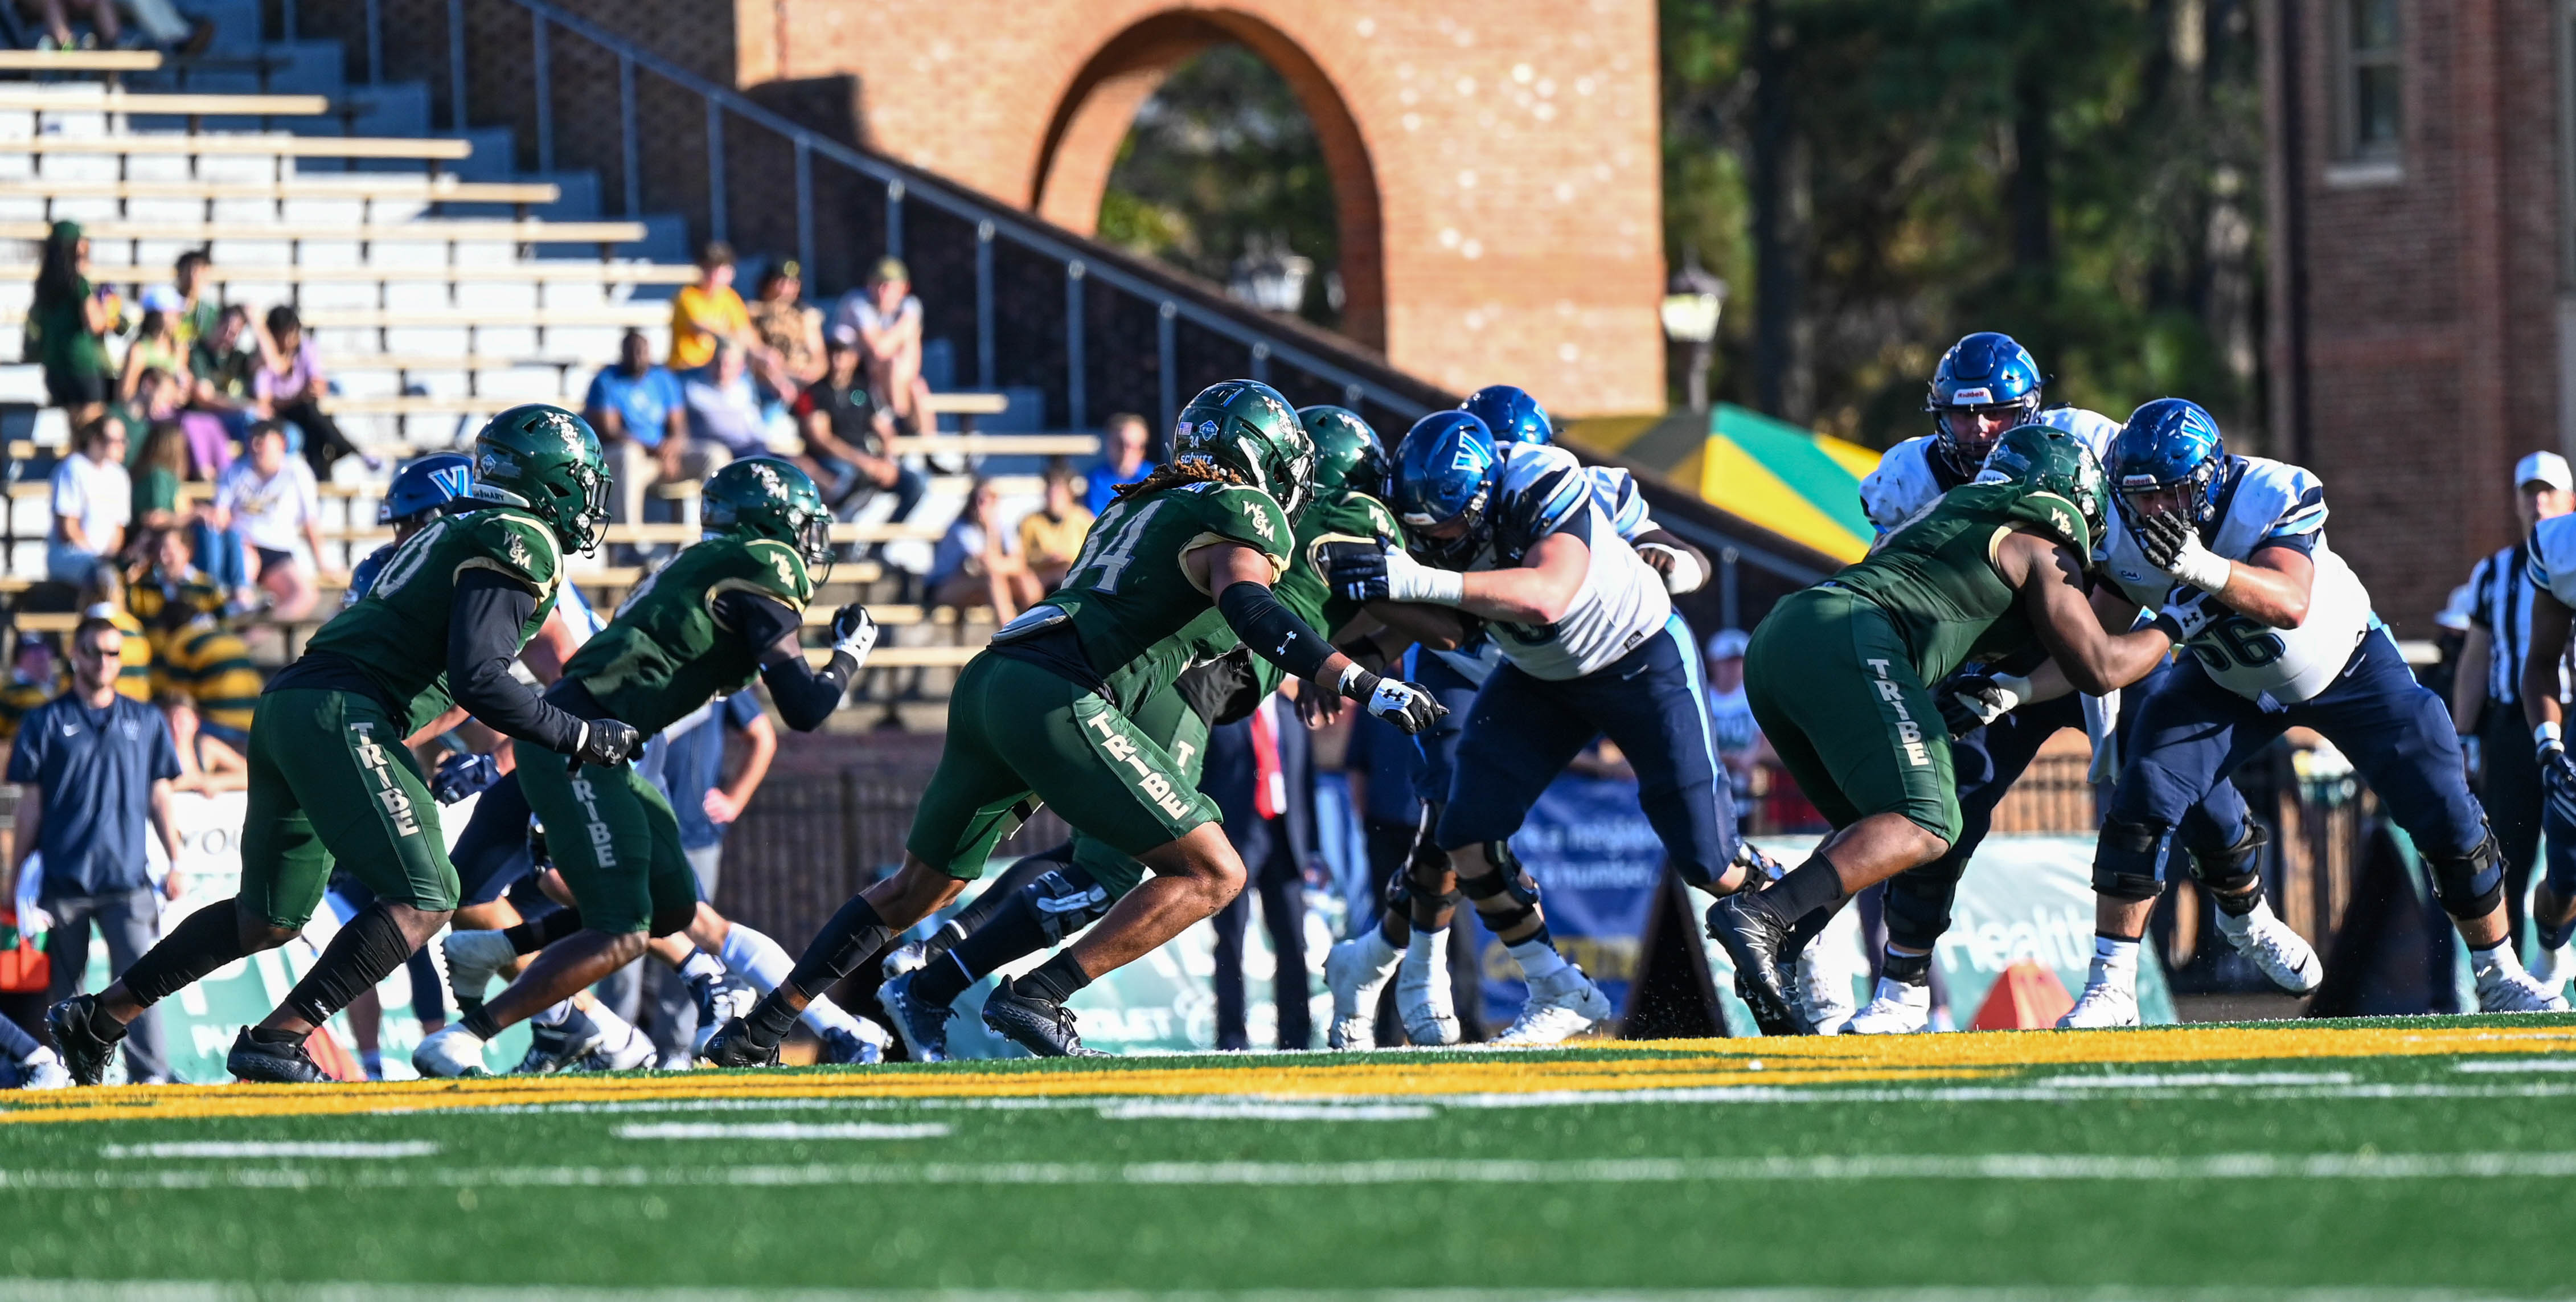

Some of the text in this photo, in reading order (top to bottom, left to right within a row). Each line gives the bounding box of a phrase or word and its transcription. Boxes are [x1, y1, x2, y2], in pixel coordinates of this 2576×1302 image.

[1189, 435, 1199, 448] 34
[2180, 406, 2218, 447] V
[1451, 431, 1494, 473] V
[428, 465, 473, 502] V
[1242, 501, 1275, 542] W&M
[504, 531, 532, 570] W&M
[1060, 501, 1166, 595] 34
[1867, 658, 1930, 766] TRIBE
[350, 722, 420, 837] TRIBE
[1087, 711, 1190, 821] TRIBE
